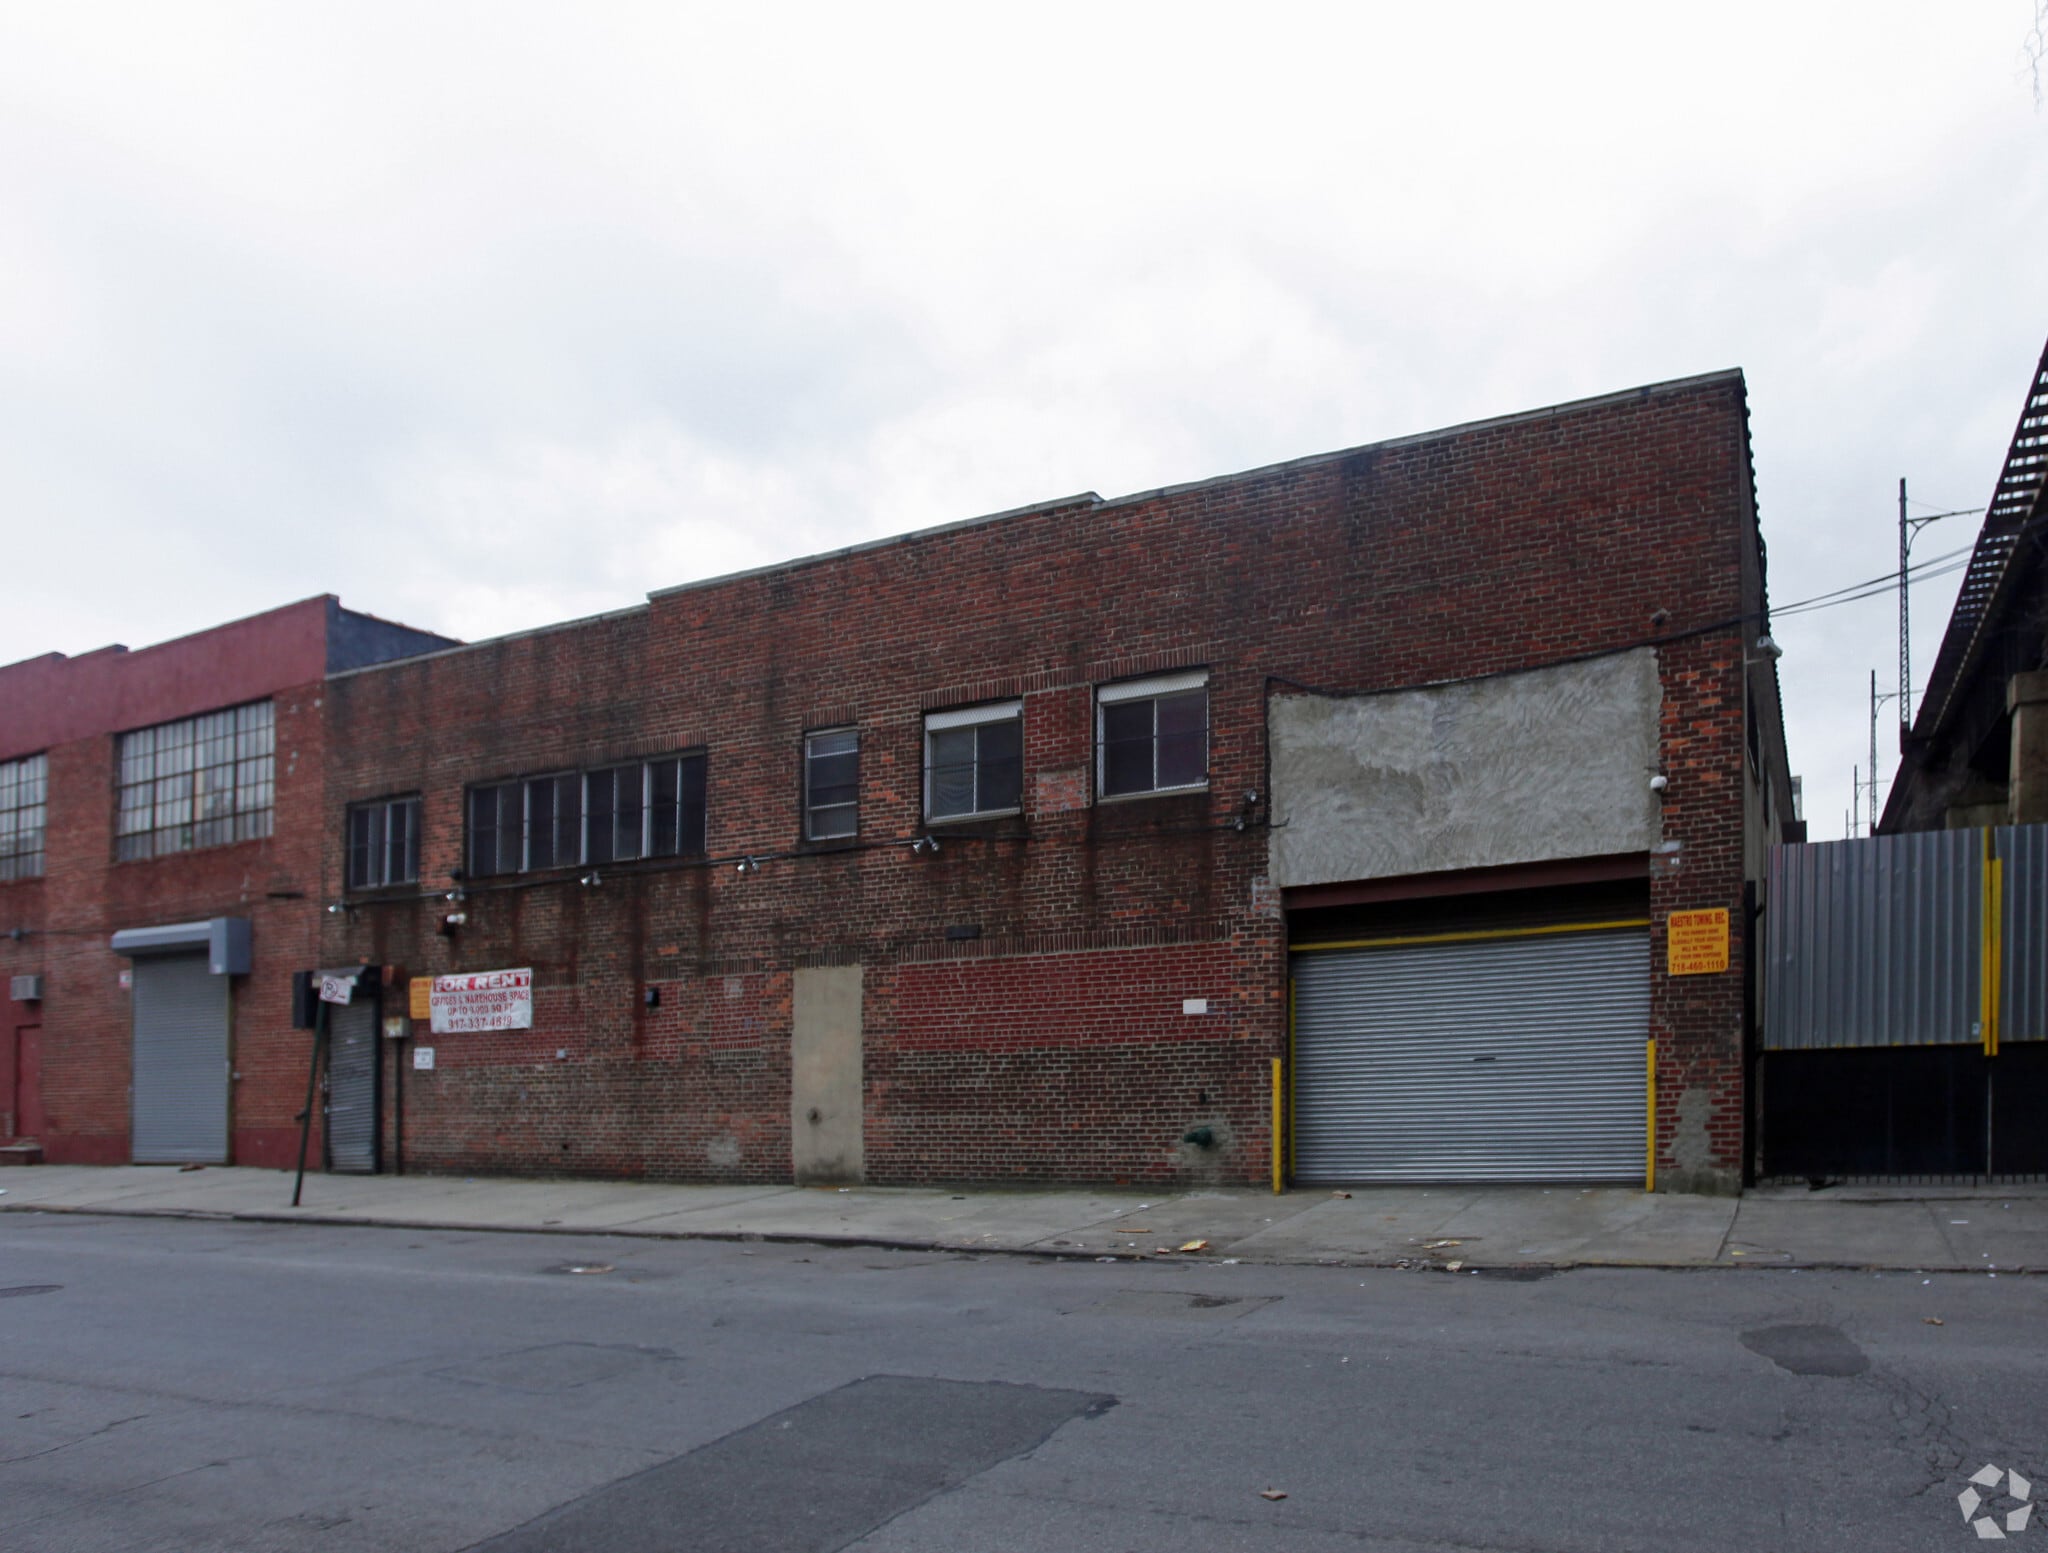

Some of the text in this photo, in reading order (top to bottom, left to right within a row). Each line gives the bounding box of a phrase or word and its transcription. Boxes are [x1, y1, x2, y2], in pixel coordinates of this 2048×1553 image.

[435, 973, 529, 992] FOR RENT
[466, 992, 508, 1005] WAREHOUSE
[510, 989, 530, 1001] SPACE
[447, 1007, 457, 1016] UP
[458, 1006, 468, 1015] TO
